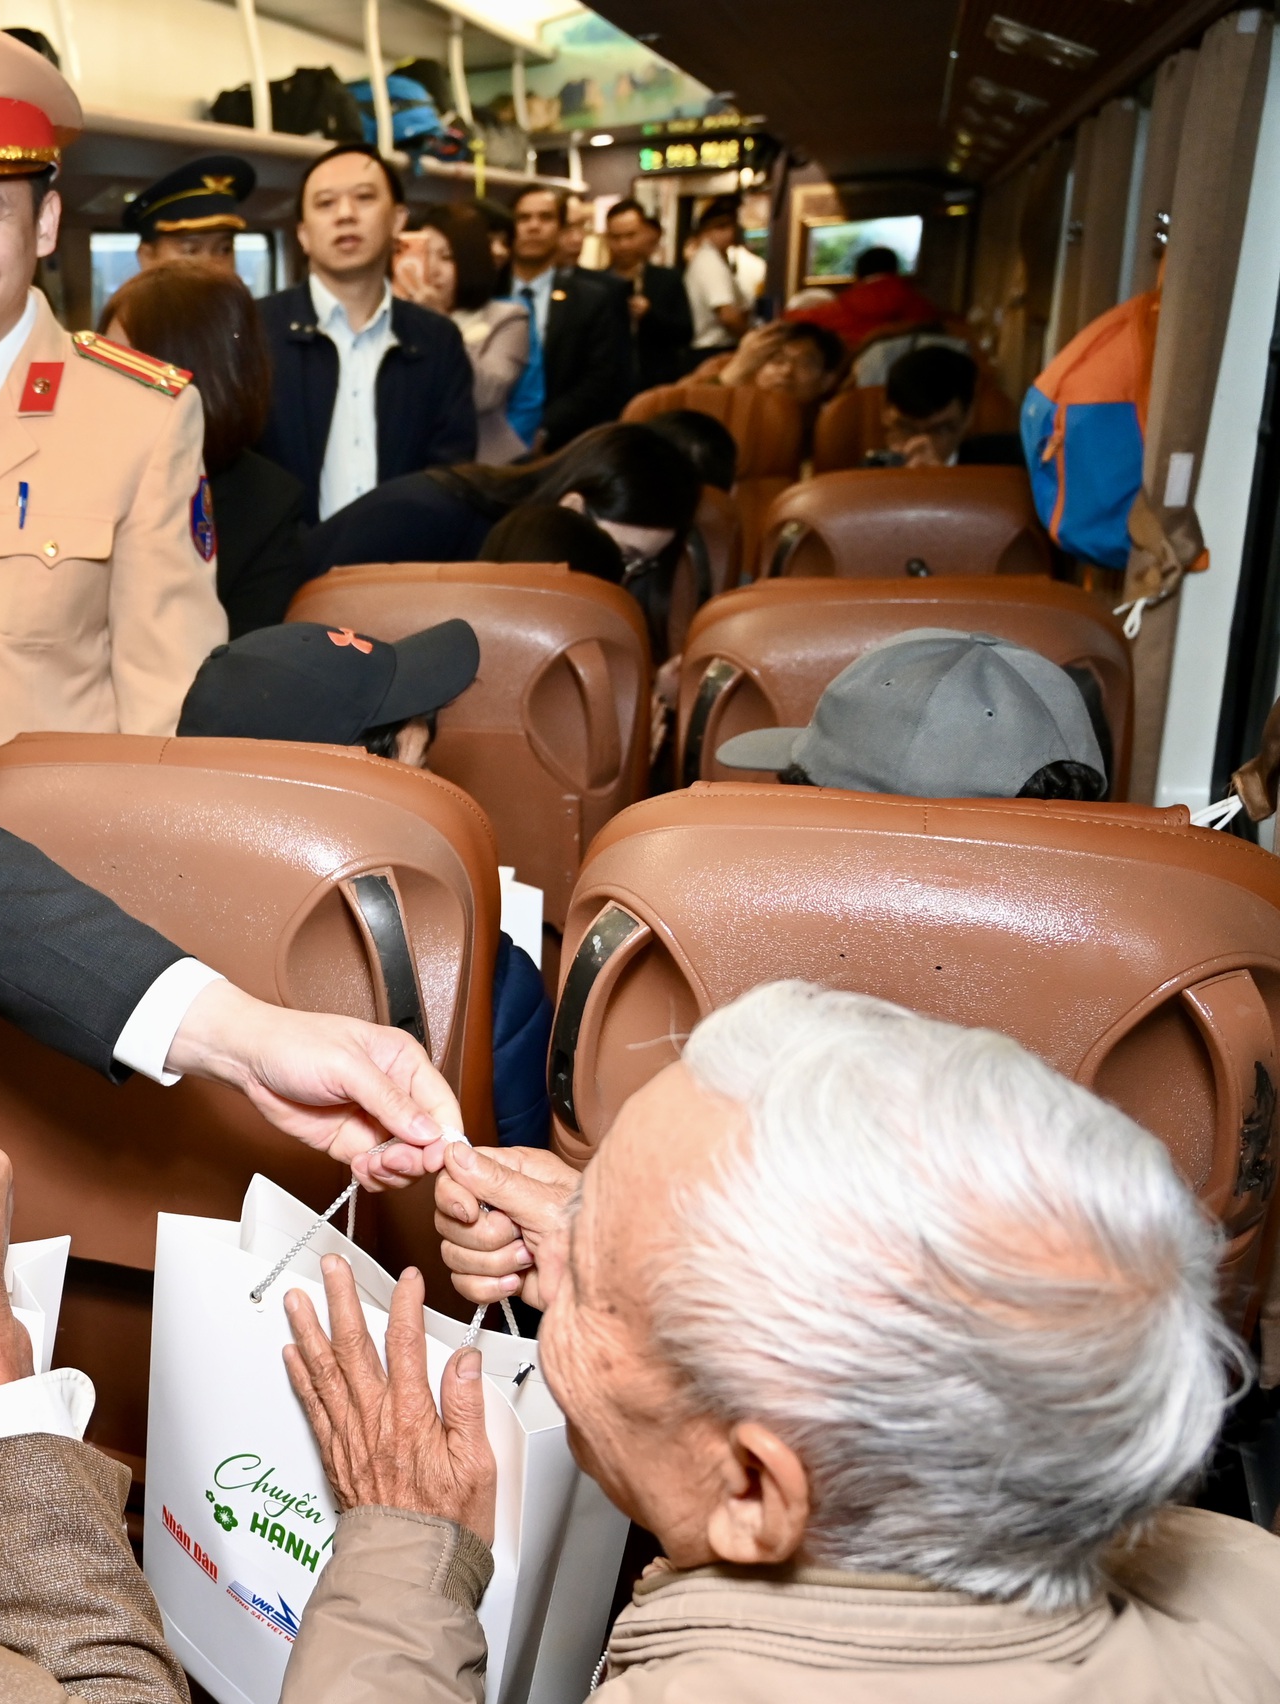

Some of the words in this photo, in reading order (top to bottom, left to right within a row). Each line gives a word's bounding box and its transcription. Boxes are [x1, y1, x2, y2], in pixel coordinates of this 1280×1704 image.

[214, 1453, 325, 1524] Chuyến
[162, 1504, 191, 1551] Nhân
[193, 1541, 218, 1580] Dân
[250, 1511, 320, 1573] HẠNH
[252, 1594, 275, 1614] VNR
